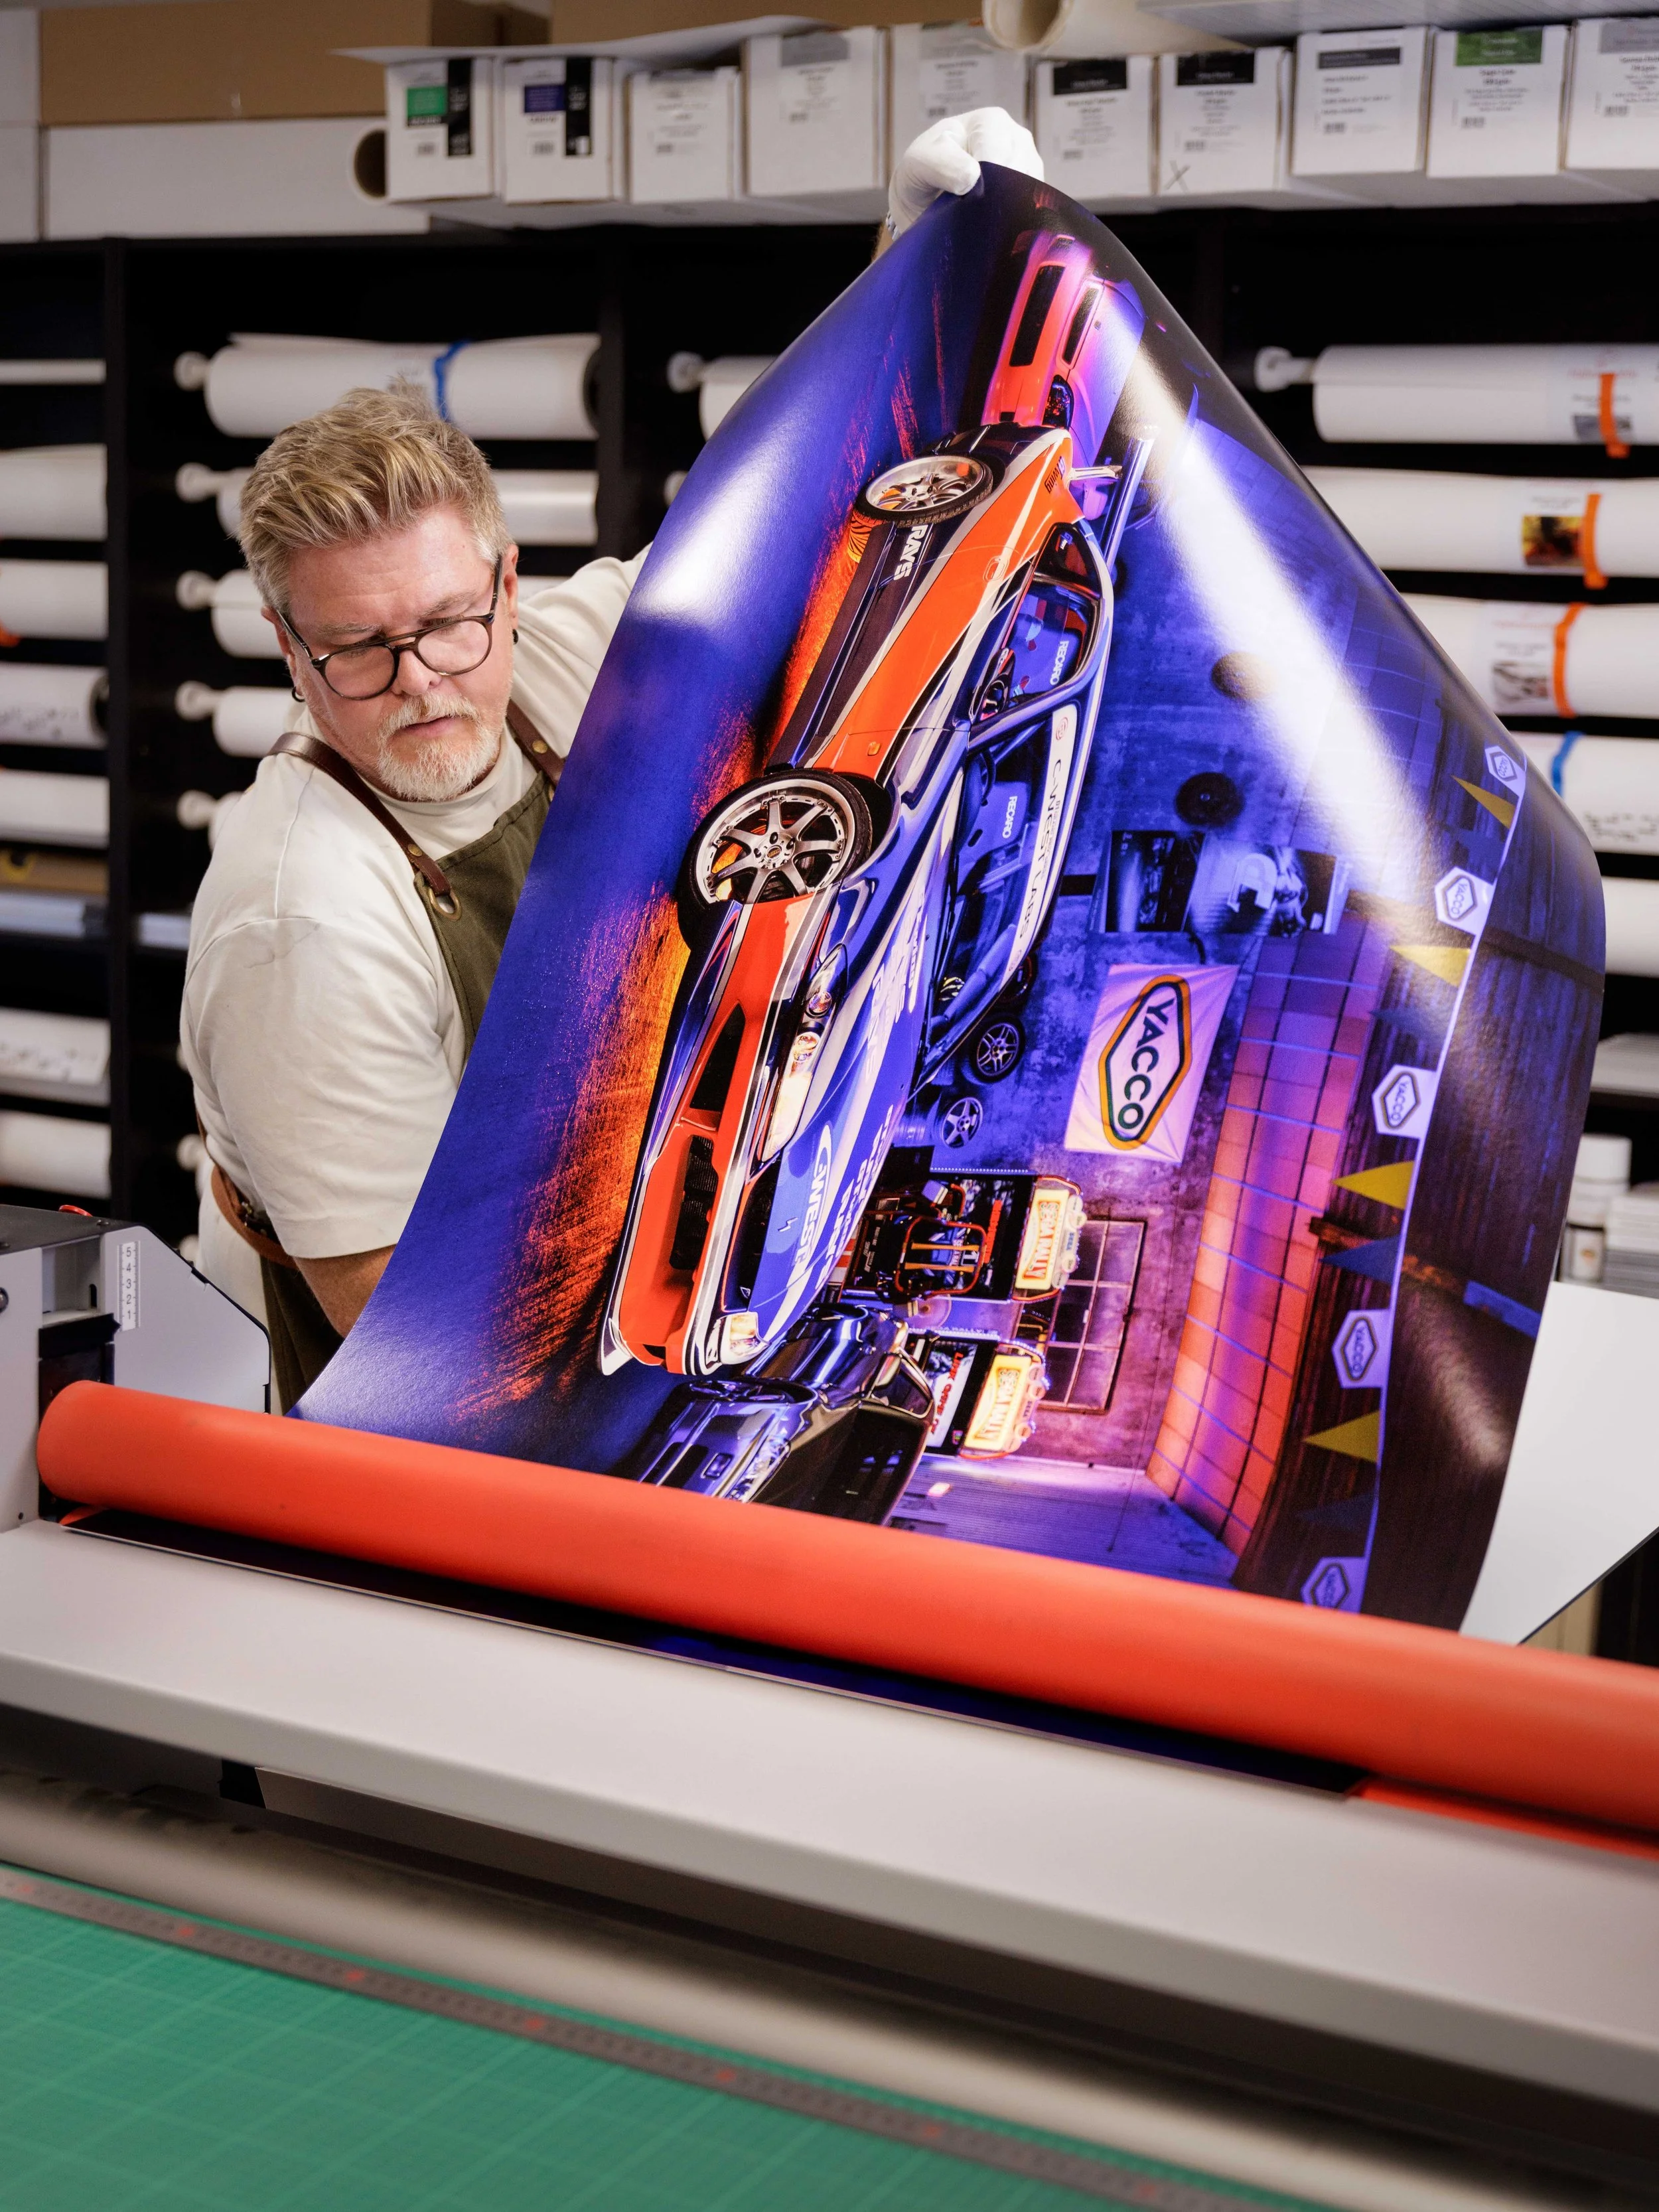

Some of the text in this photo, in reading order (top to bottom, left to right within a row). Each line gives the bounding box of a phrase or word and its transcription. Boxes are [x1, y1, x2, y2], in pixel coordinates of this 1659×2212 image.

[894, 524, 928, 581] RAYS
[1050, 640, 1069, 685] RECARO
[1002, 796, 1018, 838] RECARO
[1038, 759, 1062, 862] C-WEST
[1019, 870, 1041, 938] LABS
[1451, 883, 1467, 915] YACCO
[1118, 997, 1175, 1130] YACCO
[1391, 1080, 1409, 1121] YACCO
[126, 1247, 131, 1257] 5
[126, 1263, 131, 1272] 4
[1025, 1236, 1053, 1278] RALLY
[126, 1278, 131, 1289] 3
[126, 1294, 132, 1305] 2
[127, 1309, 131, 1320] 1
